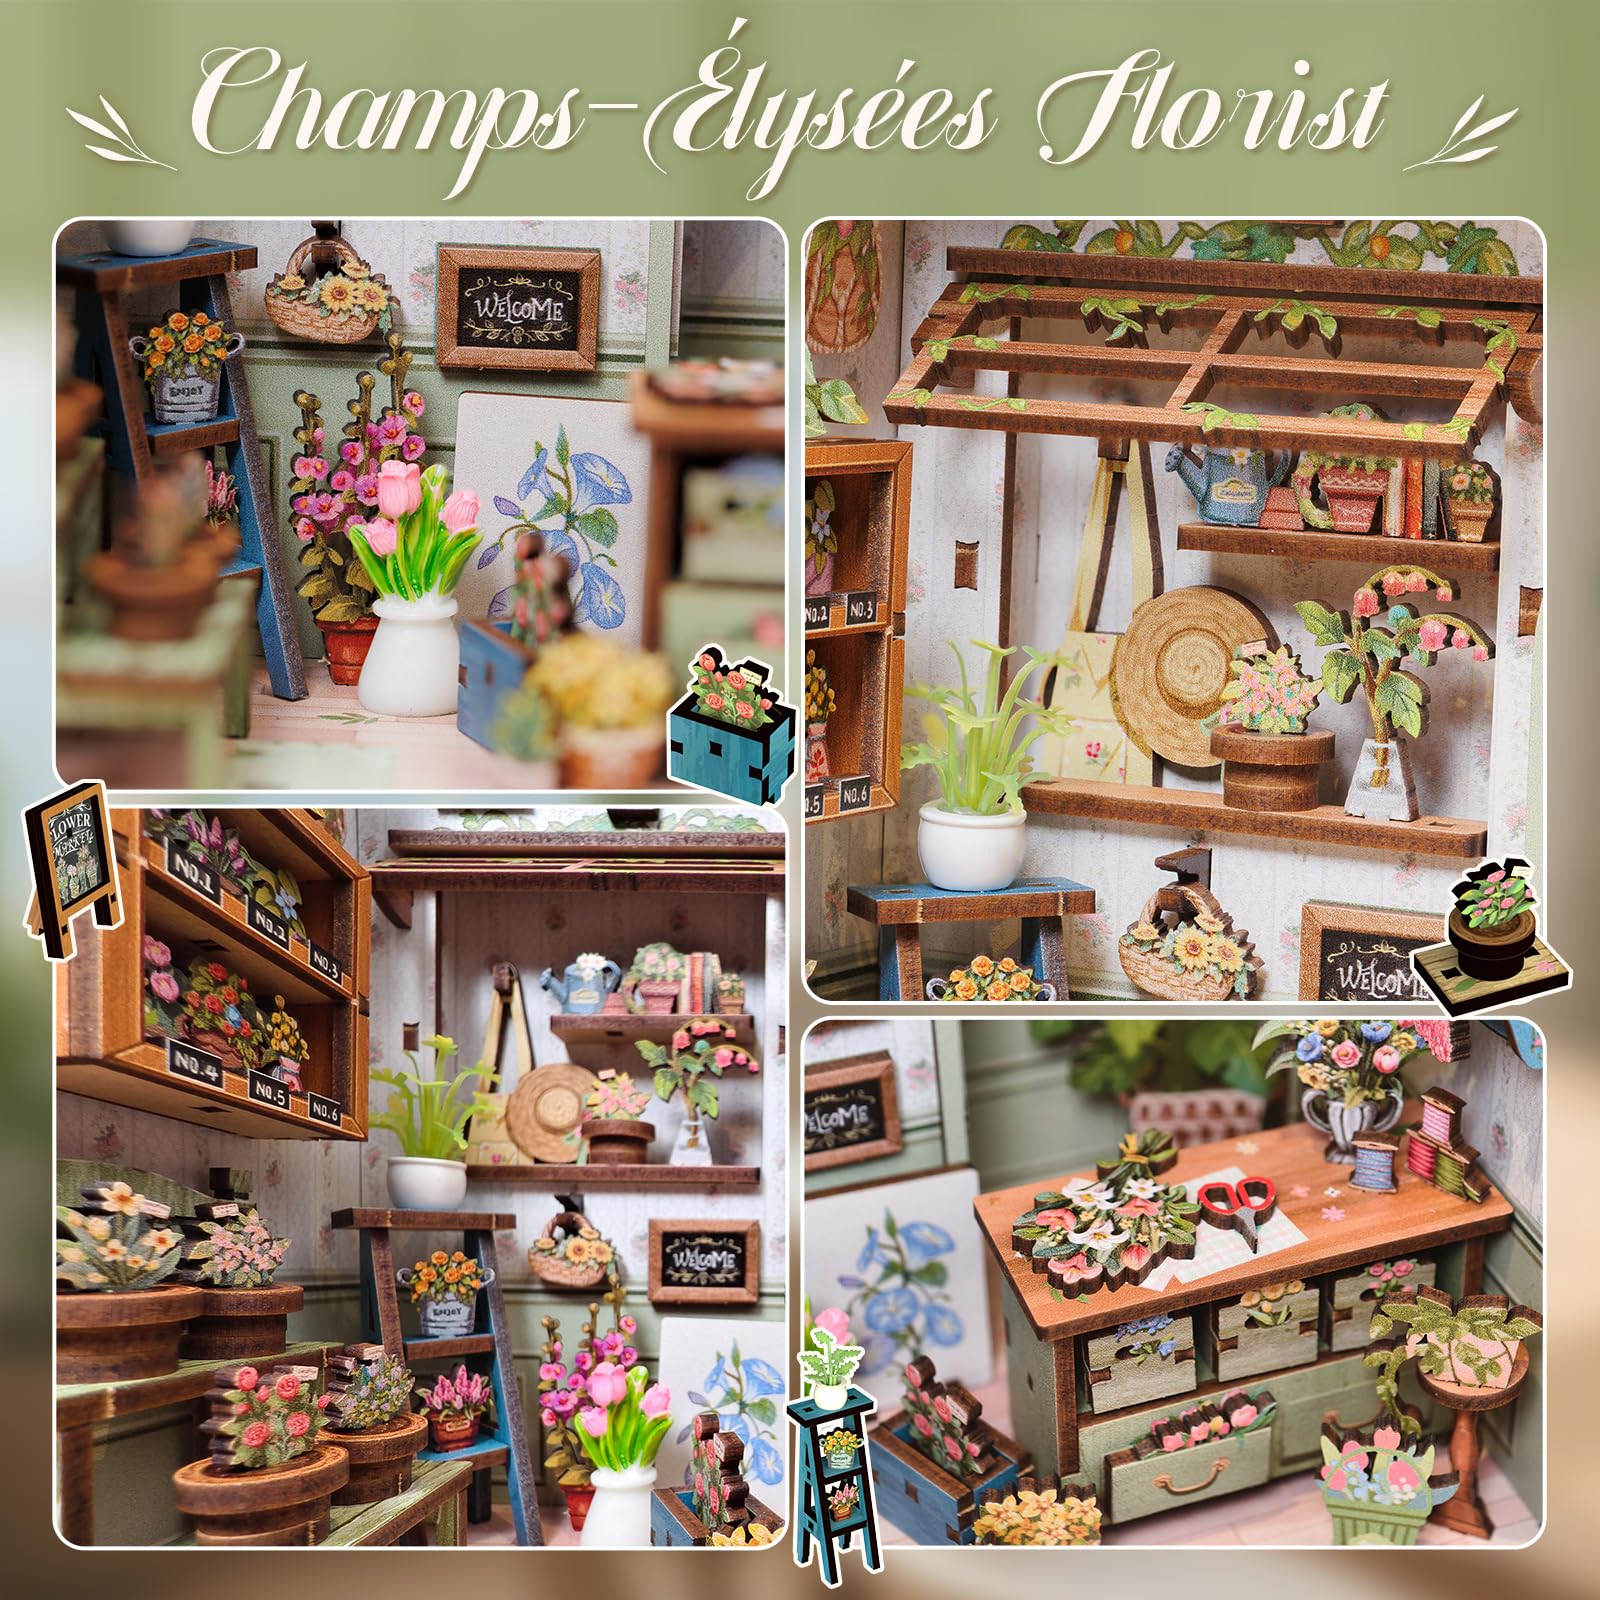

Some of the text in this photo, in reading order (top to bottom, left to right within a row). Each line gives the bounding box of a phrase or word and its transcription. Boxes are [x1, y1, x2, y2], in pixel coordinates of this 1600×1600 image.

[474, 289, 564, 324] WELCOME
[169, 385, 204, 397] ENJOY
[850, 601, 874, 619] NO.3
[805, 795, 820, 814] O.5
[843, 785, 868, 804] NO.6
[49, 813, 91, 843] LOWER
[174, 856, 215, 895] NO.1
[255, 909, 287, 942] NO.2
[313, 951, 339, 979] NO.3
[174, 1051, 219, 1082] NO.4
[255, 1080, 286, 1106] NO.5
[313, 1102, 338, 1121] NO.6
[804, 1103, 869, 1134] ELCOME
[673, 1246, 736, 1272] WELCOME
